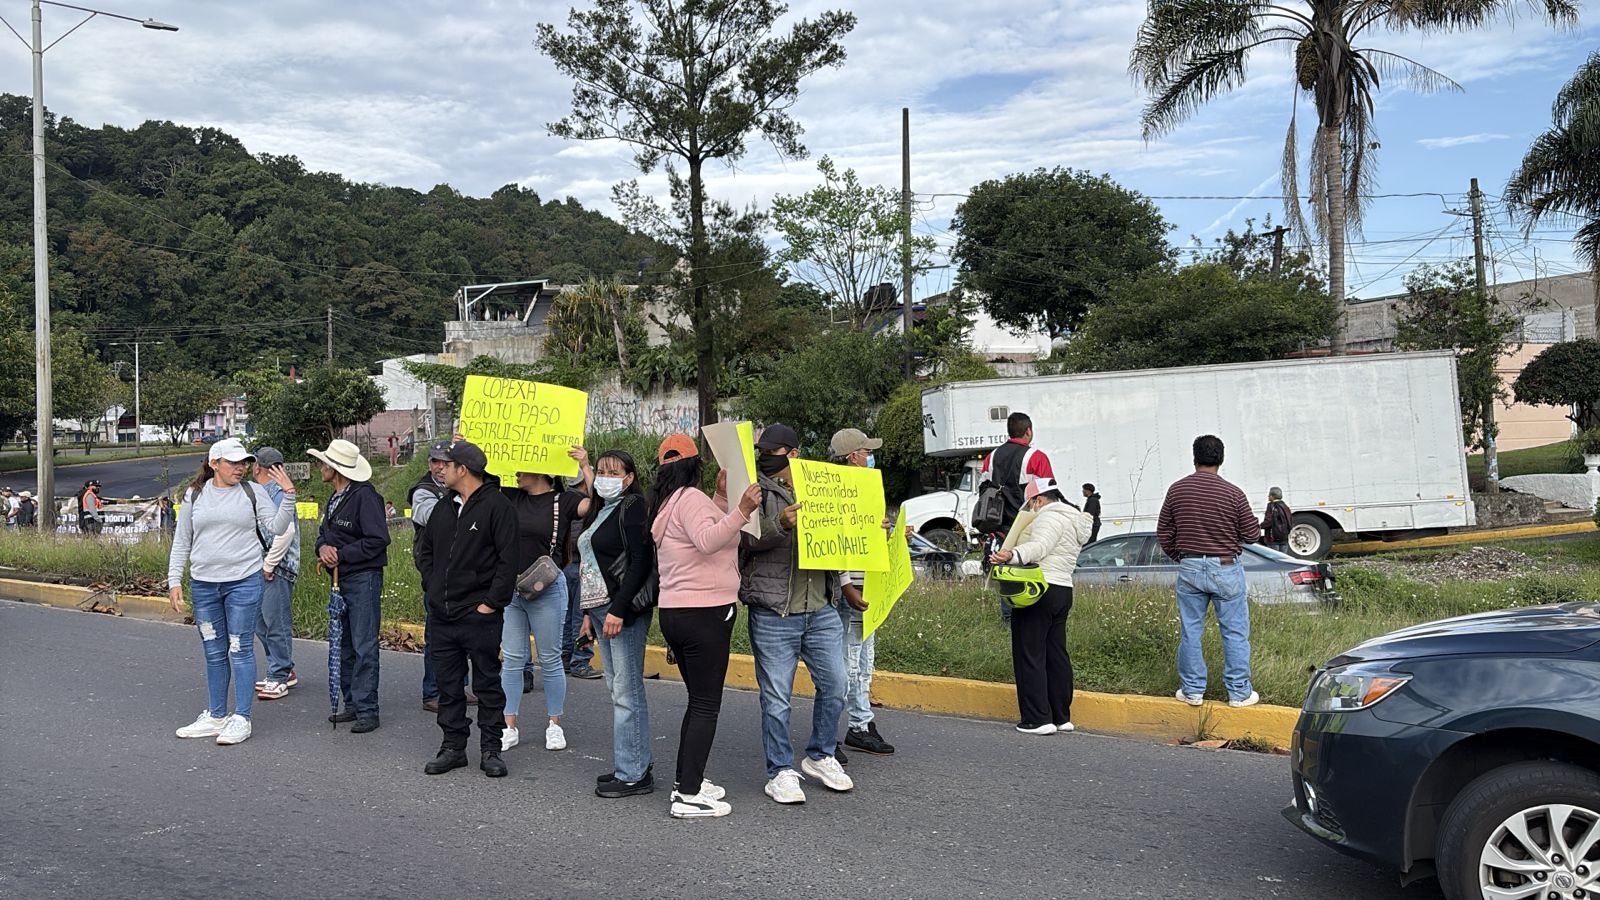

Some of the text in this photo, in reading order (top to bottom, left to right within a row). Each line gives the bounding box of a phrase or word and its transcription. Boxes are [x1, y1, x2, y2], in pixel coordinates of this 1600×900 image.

[482, 377, 537, 401] COPEXA
[464, 398, 492, 419] CON
[496, 402, 513, 420] TU
[519, 402, 561, 426] PASO
[459, 419, 580, 446] DESTRUISTE NUESTRA
[957, 435, 985, 446] STAFF
[801, 461, 842, 485] Nuestra
[850, 513, 875, 530] digna
[804, 532, 870, 559] ROCIO NAHLE
